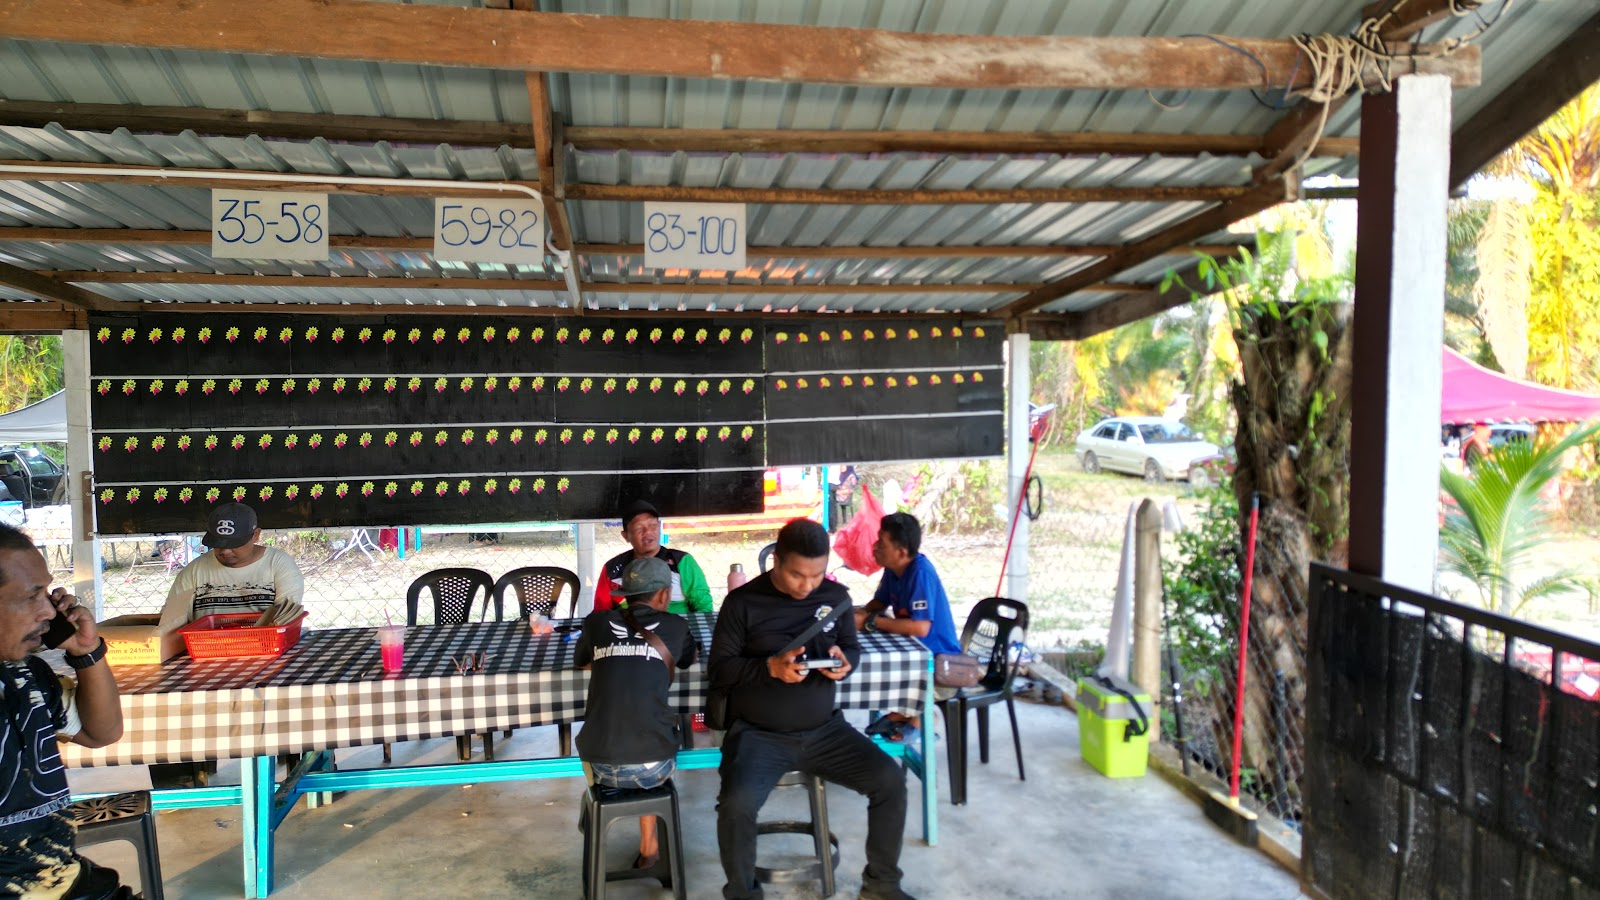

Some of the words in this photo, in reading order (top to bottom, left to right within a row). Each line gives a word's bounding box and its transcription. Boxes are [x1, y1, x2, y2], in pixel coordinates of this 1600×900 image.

[218, 199, 323, 244] 35-58
[441, 205, 538, 249] 59-82
[648, 212, 738, 255] 83-100
[606, 642, 614, 658] of
[612, 642, 636, 657] mission
[636, 642, 648, 657] and
